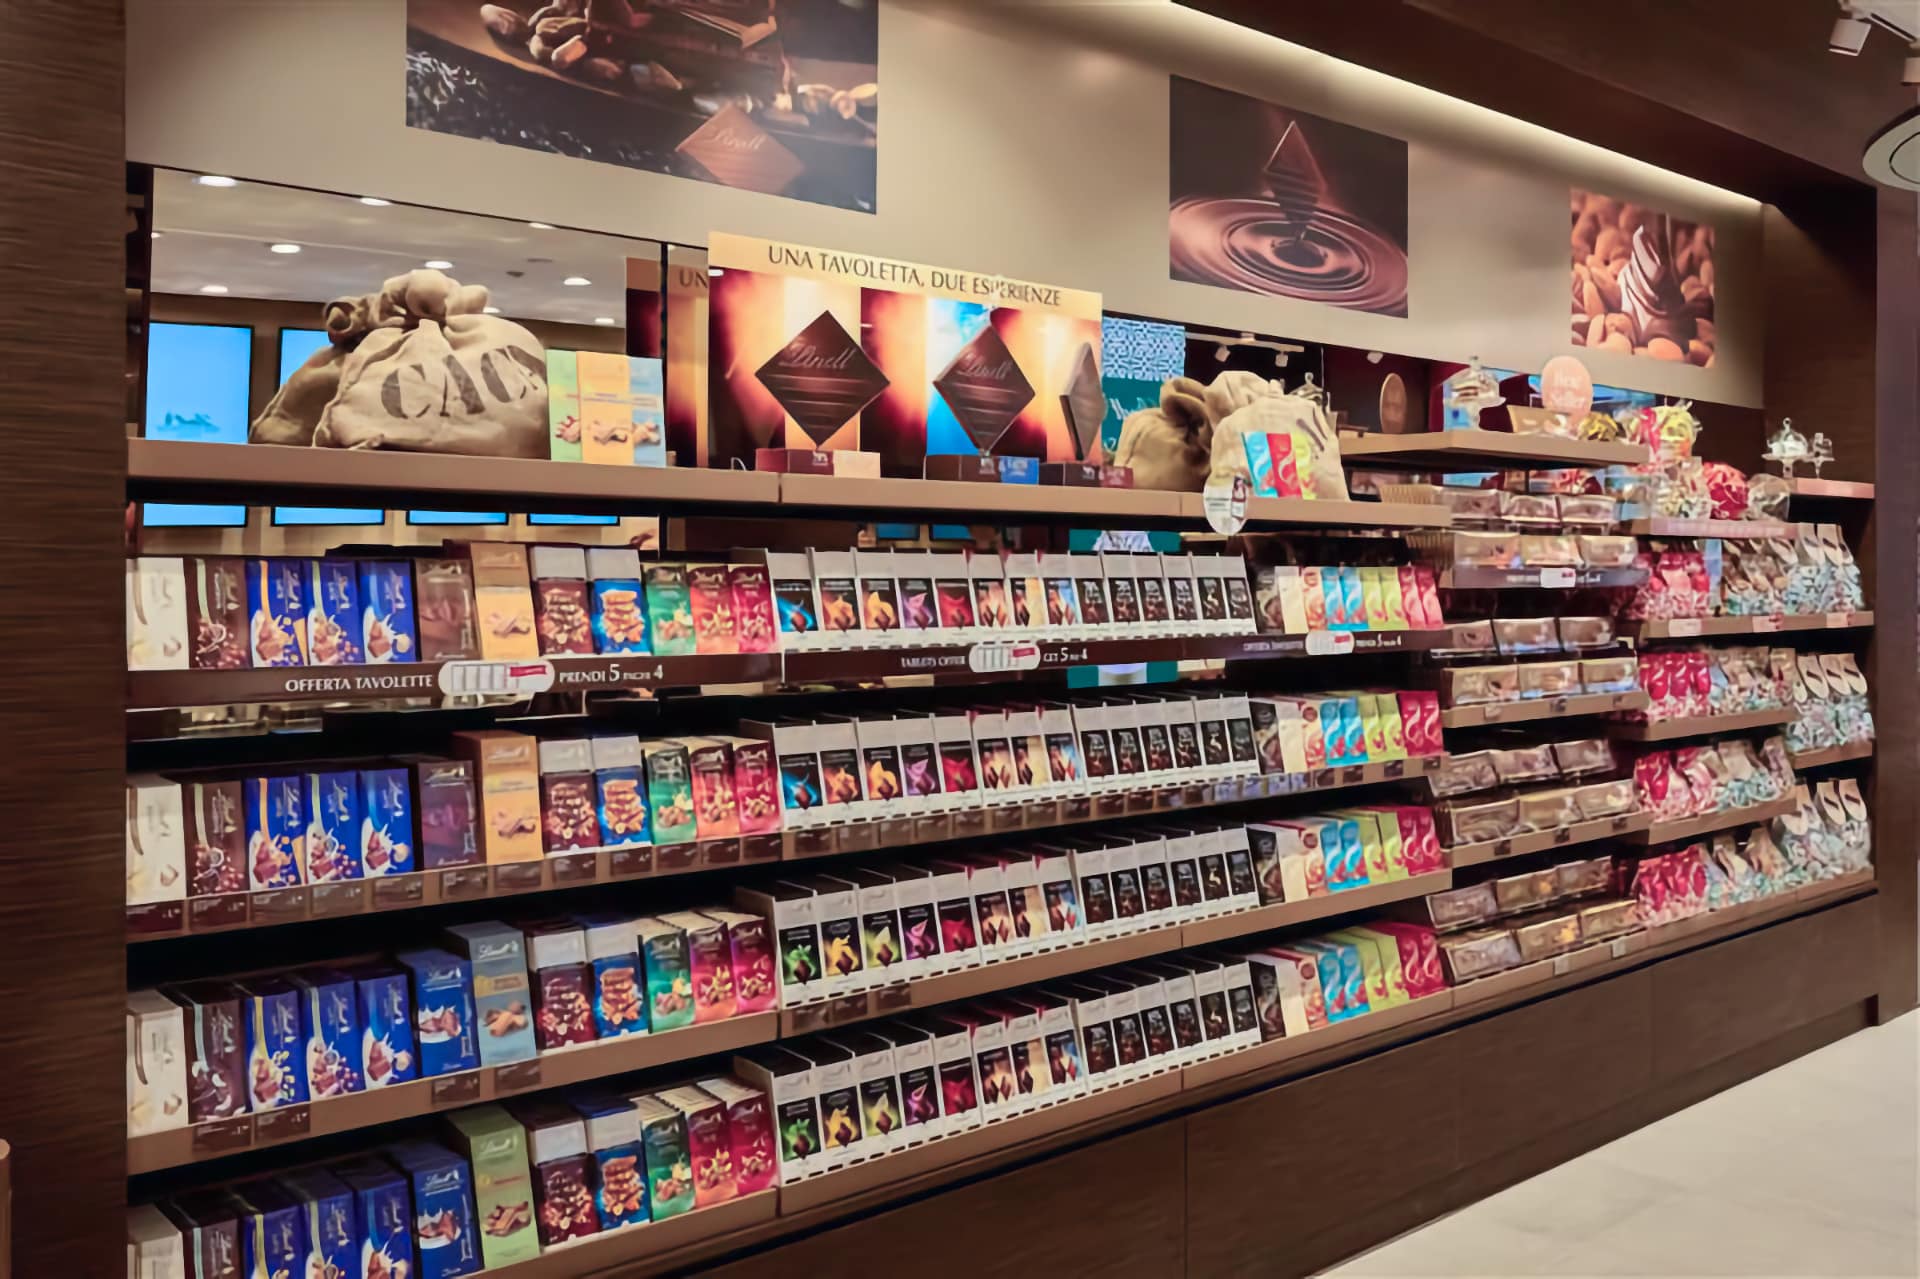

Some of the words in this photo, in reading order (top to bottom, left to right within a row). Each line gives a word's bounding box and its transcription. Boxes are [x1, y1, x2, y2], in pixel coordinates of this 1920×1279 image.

[768, 245, 814, 270] UNA
[819, 252, 925, 287] TAVOLETTA,
[931, 271, 967, 293] DUE
[1060, 647, 1069, 662] 5
[559, 670, 606, 683] PRENDI
[609, 663, 620, 682] 5
[653, 664, 664, 680] 4
[285, 678, 351, 692] OFFERTA
[355, 674, 433, 689] TAVOLETTE
